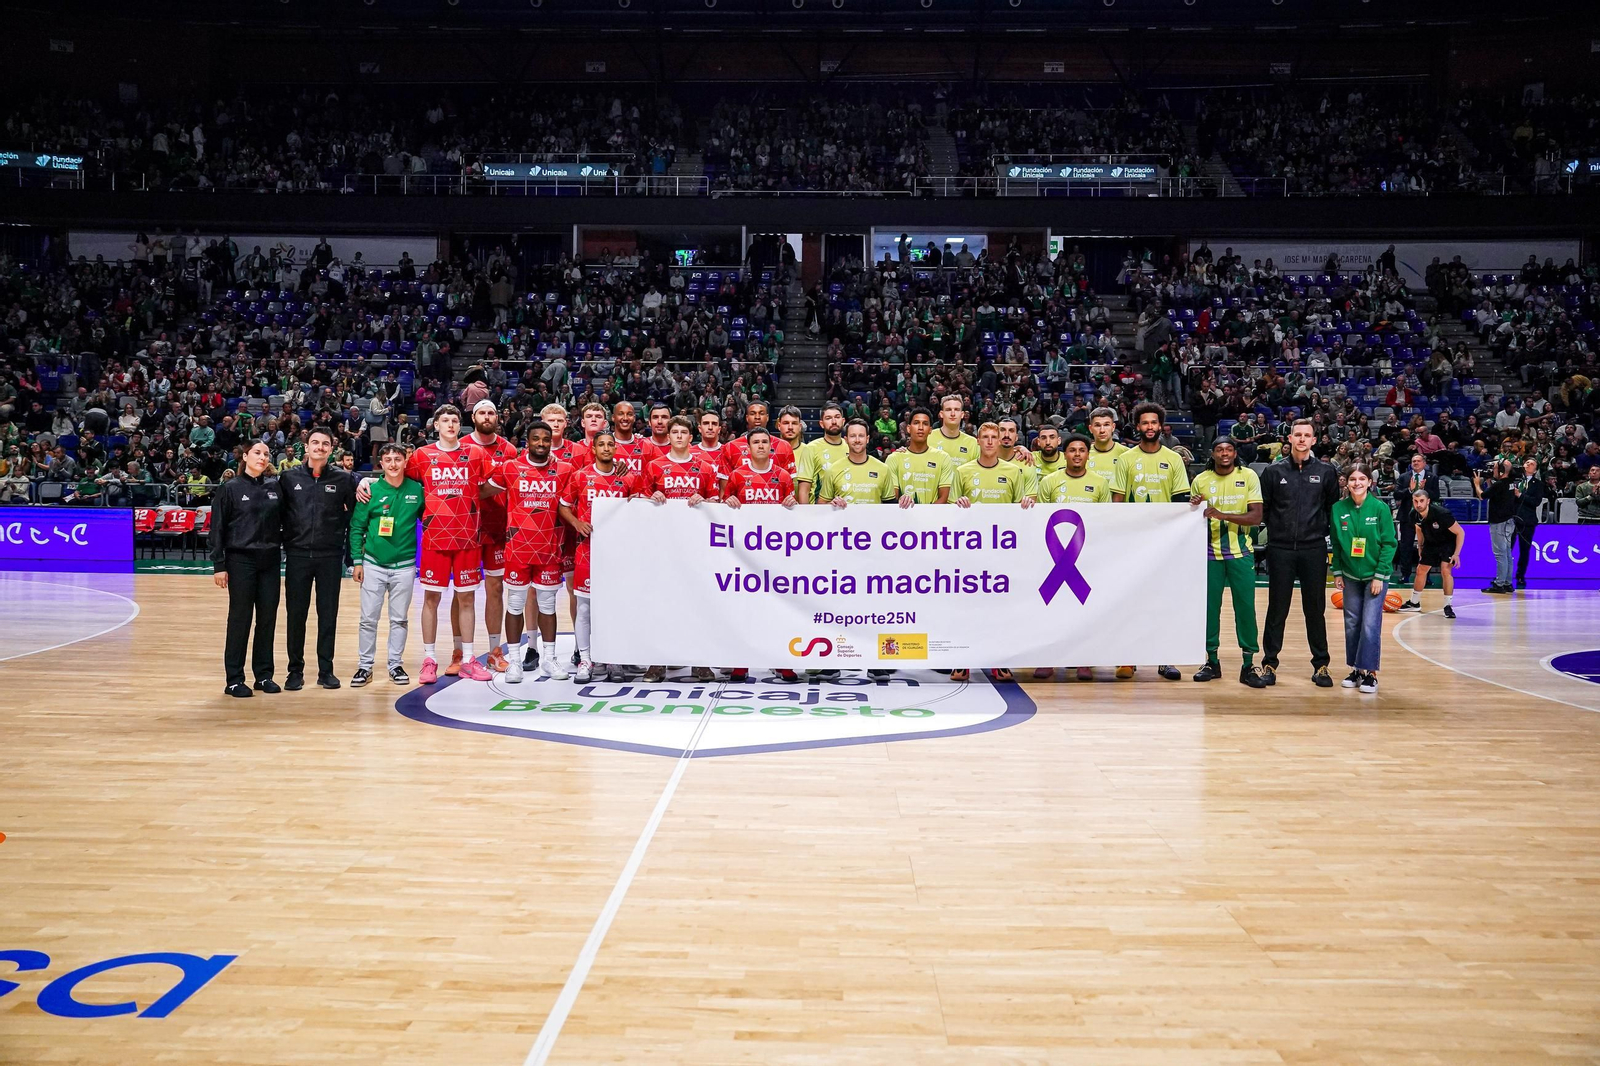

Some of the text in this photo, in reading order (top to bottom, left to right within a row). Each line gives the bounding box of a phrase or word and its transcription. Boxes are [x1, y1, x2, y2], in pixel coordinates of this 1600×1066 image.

[490, 168, 515, 176] Unicaja
[542, 168, 568, 176] Unicaja
[431, 467, 469, 480] BAXI
[519, 480, 557, 492] BAXI
[664, 476, 700, 488] BAXI
[437, 488, 463, 496] MANRESA
[745, 488, 779, 500] BAXI
[171, 512, 187, 522] 12
[709, 522, 1017, 557] El deporte contra la
[715, 567, 1010, 595] violencia machista
[813, 611, 916, 627] #Deporte25N
[577, 686, 869, 704] Unicaja
[489, 699, 935, 718] Baloncesto
